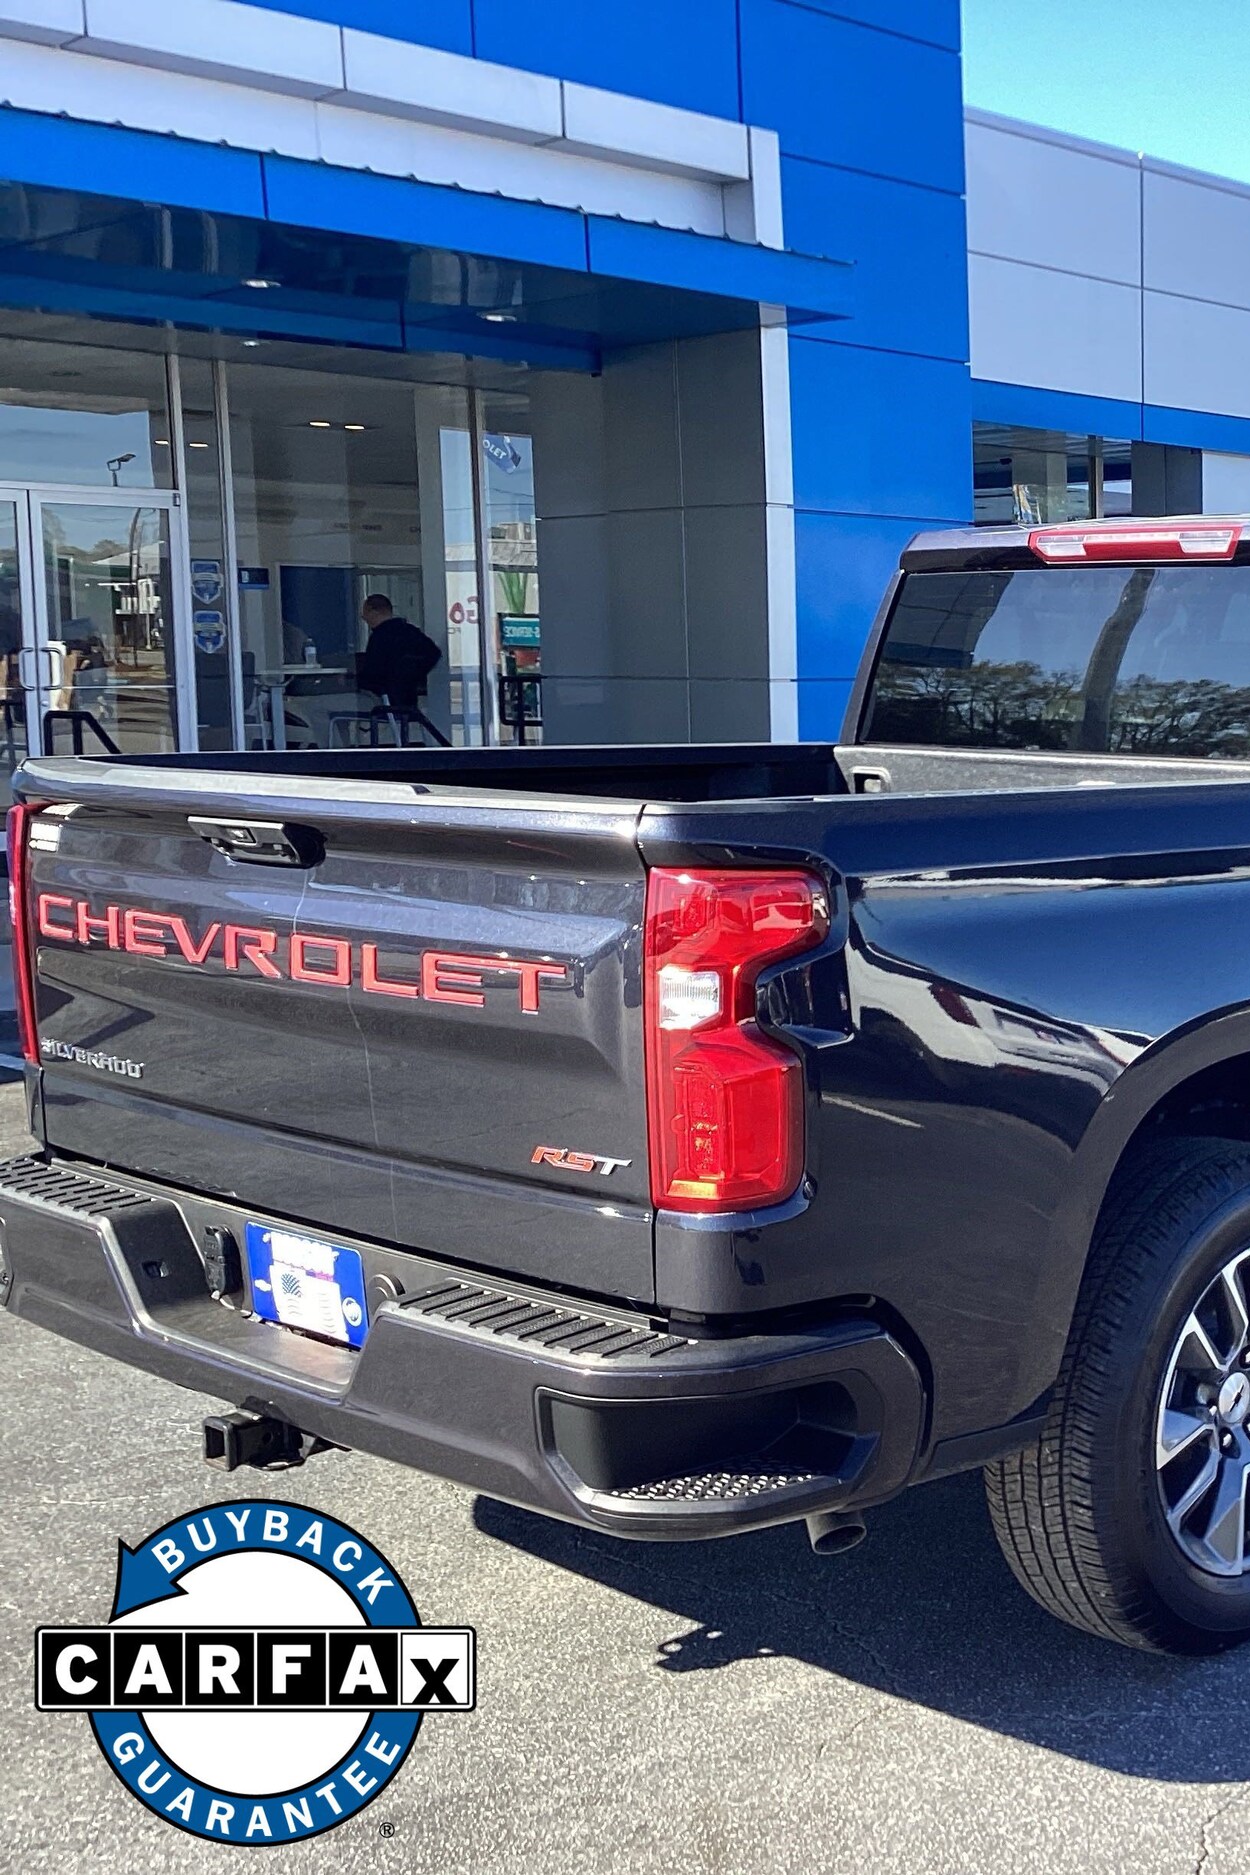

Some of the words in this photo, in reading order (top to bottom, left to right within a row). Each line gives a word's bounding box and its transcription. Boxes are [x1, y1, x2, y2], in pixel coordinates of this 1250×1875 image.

[38, 893, 568, 1014] CHEVROLET
[41, 1037, 145, 1078] SILVERADO
[530, 1146, 632, 1176] RST
